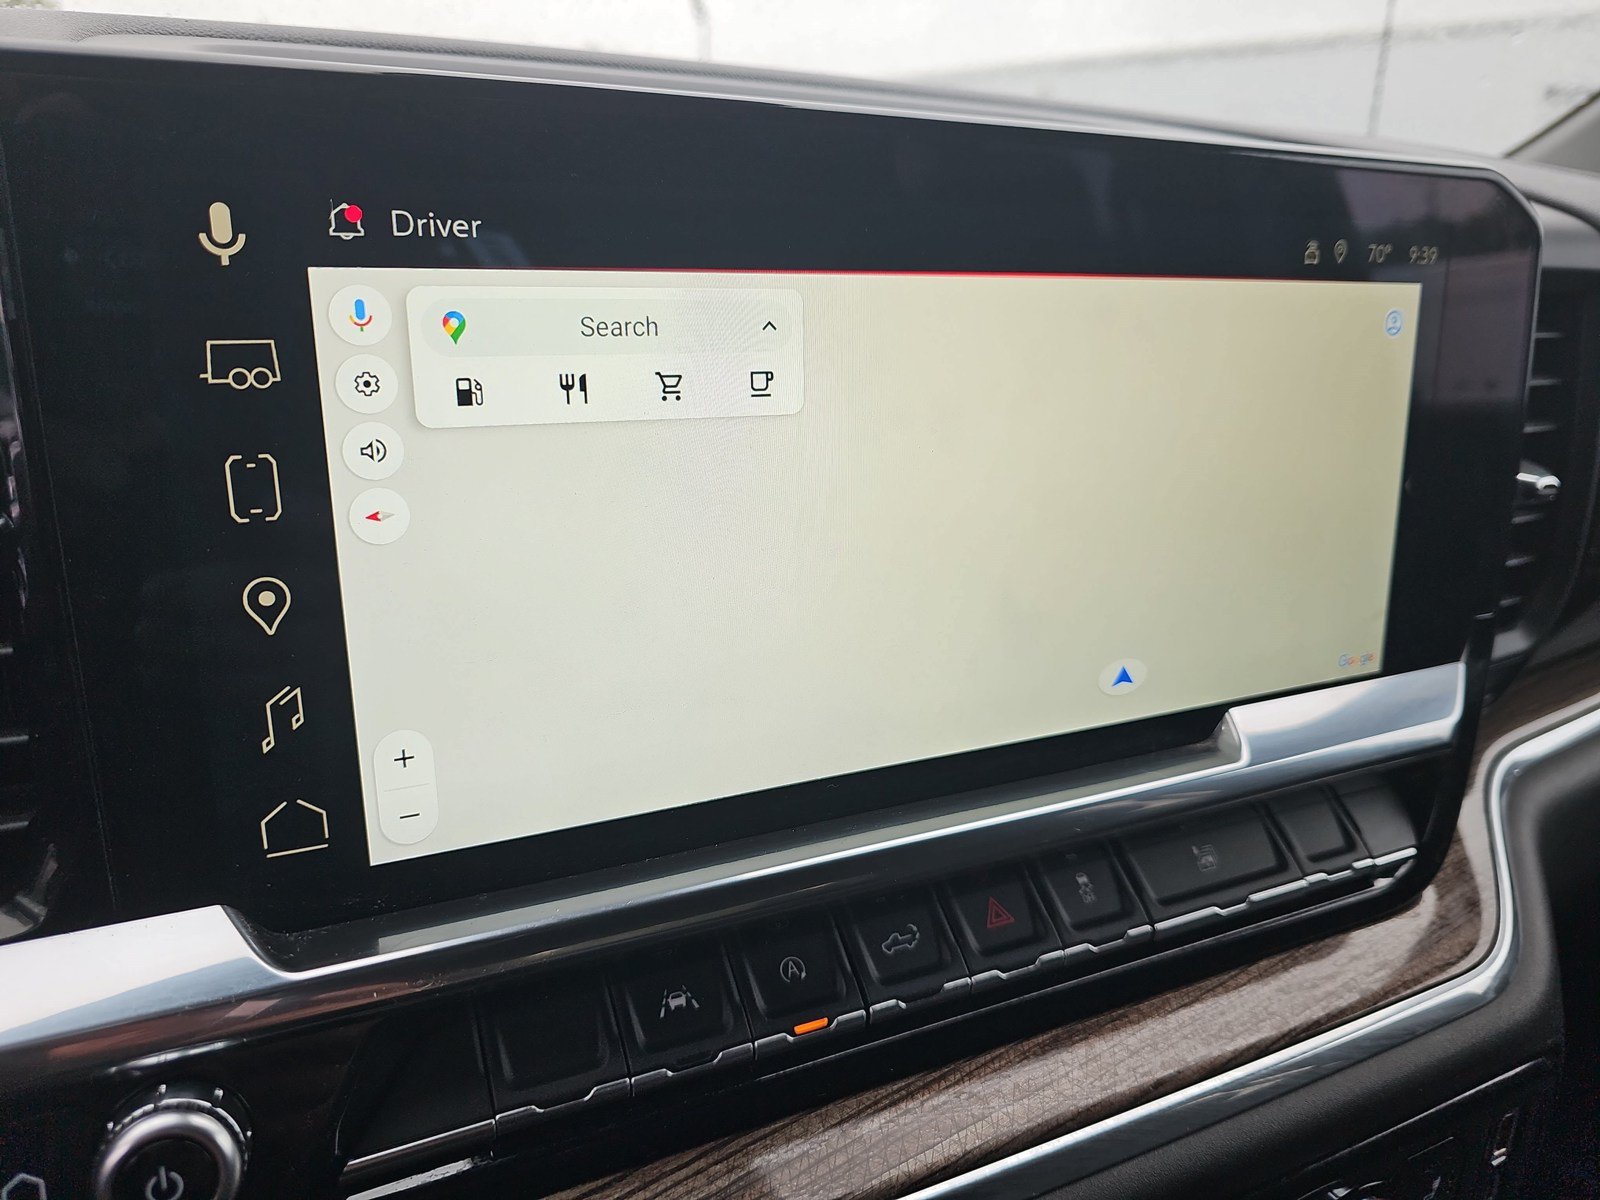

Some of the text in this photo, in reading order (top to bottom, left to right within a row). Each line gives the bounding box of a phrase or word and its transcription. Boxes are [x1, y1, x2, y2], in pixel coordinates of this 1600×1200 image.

[390, 209, 482, 239] Driver
[1409, 245, 1439, 265] 9:39
[579, 315, 659, 337] Search
